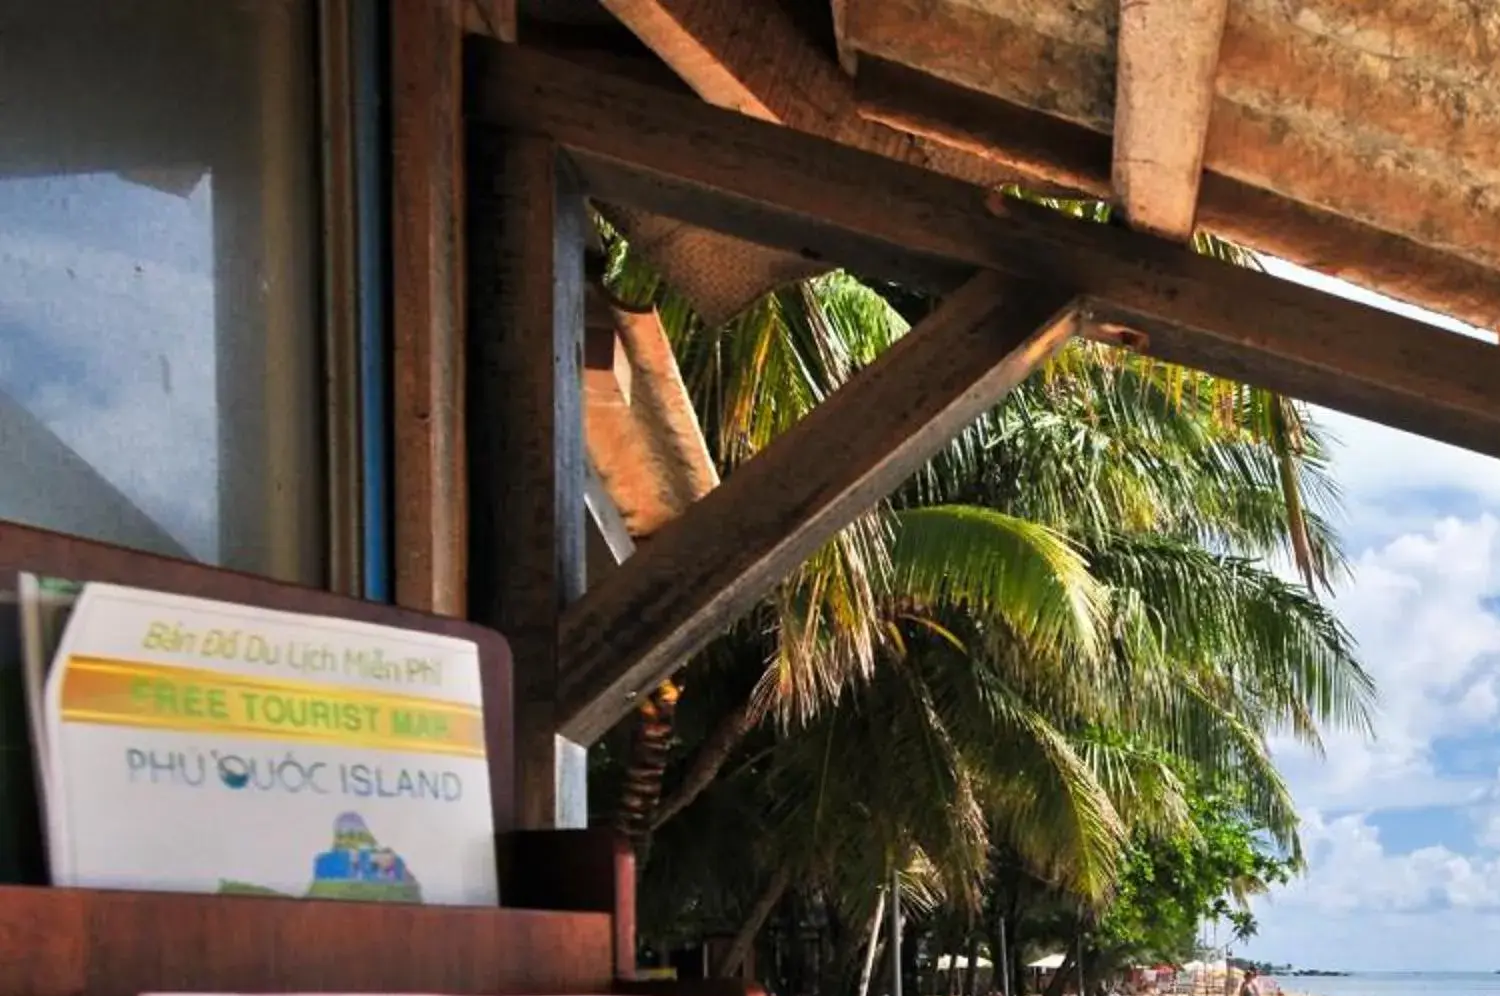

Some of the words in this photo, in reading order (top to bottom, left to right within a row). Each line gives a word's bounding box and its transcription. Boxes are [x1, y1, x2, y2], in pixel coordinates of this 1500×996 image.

[243, 633, 280, 666] Du
[131, 678, 230, 719] FREE
[243, 693, 380, 734] TOURIST
[390, 710, 450, 739] MAP
[339, 763, 464, 804] ISLAND
